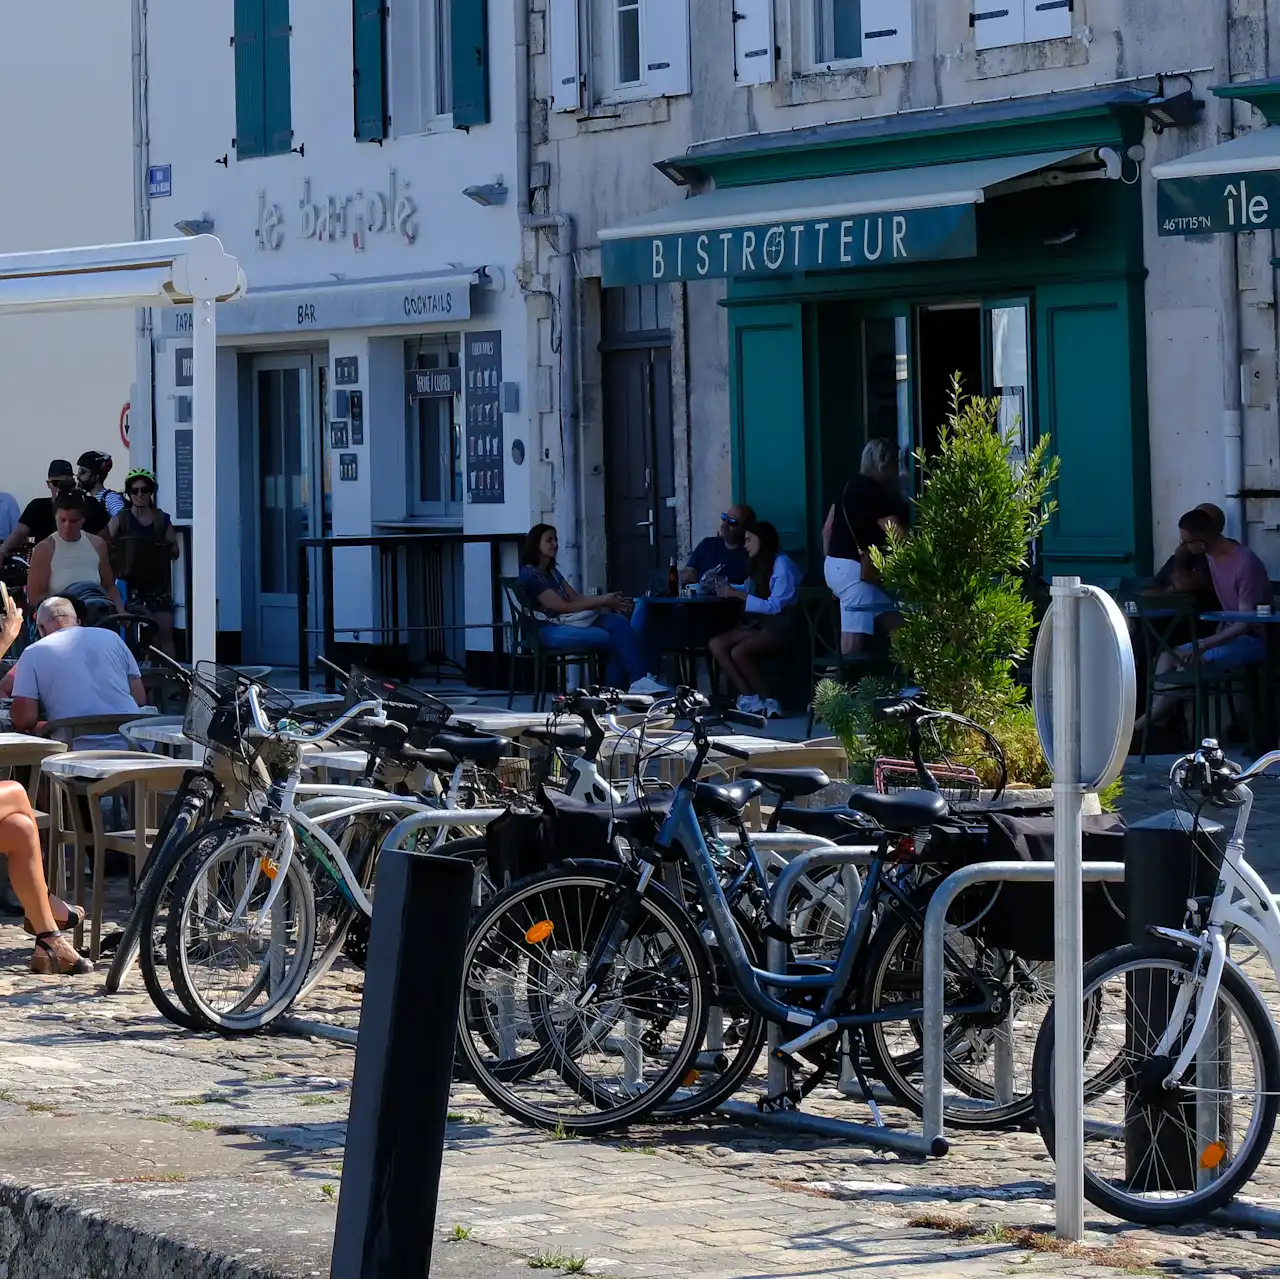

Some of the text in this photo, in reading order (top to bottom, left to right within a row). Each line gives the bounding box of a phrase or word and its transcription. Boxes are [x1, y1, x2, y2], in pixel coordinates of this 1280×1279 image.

[1223, 180, 1269, 226] île
[652, 215, 908, 278] BISTROTTEUR
[176, 291, 453, 333] TAPA BAR COCKTAILS
